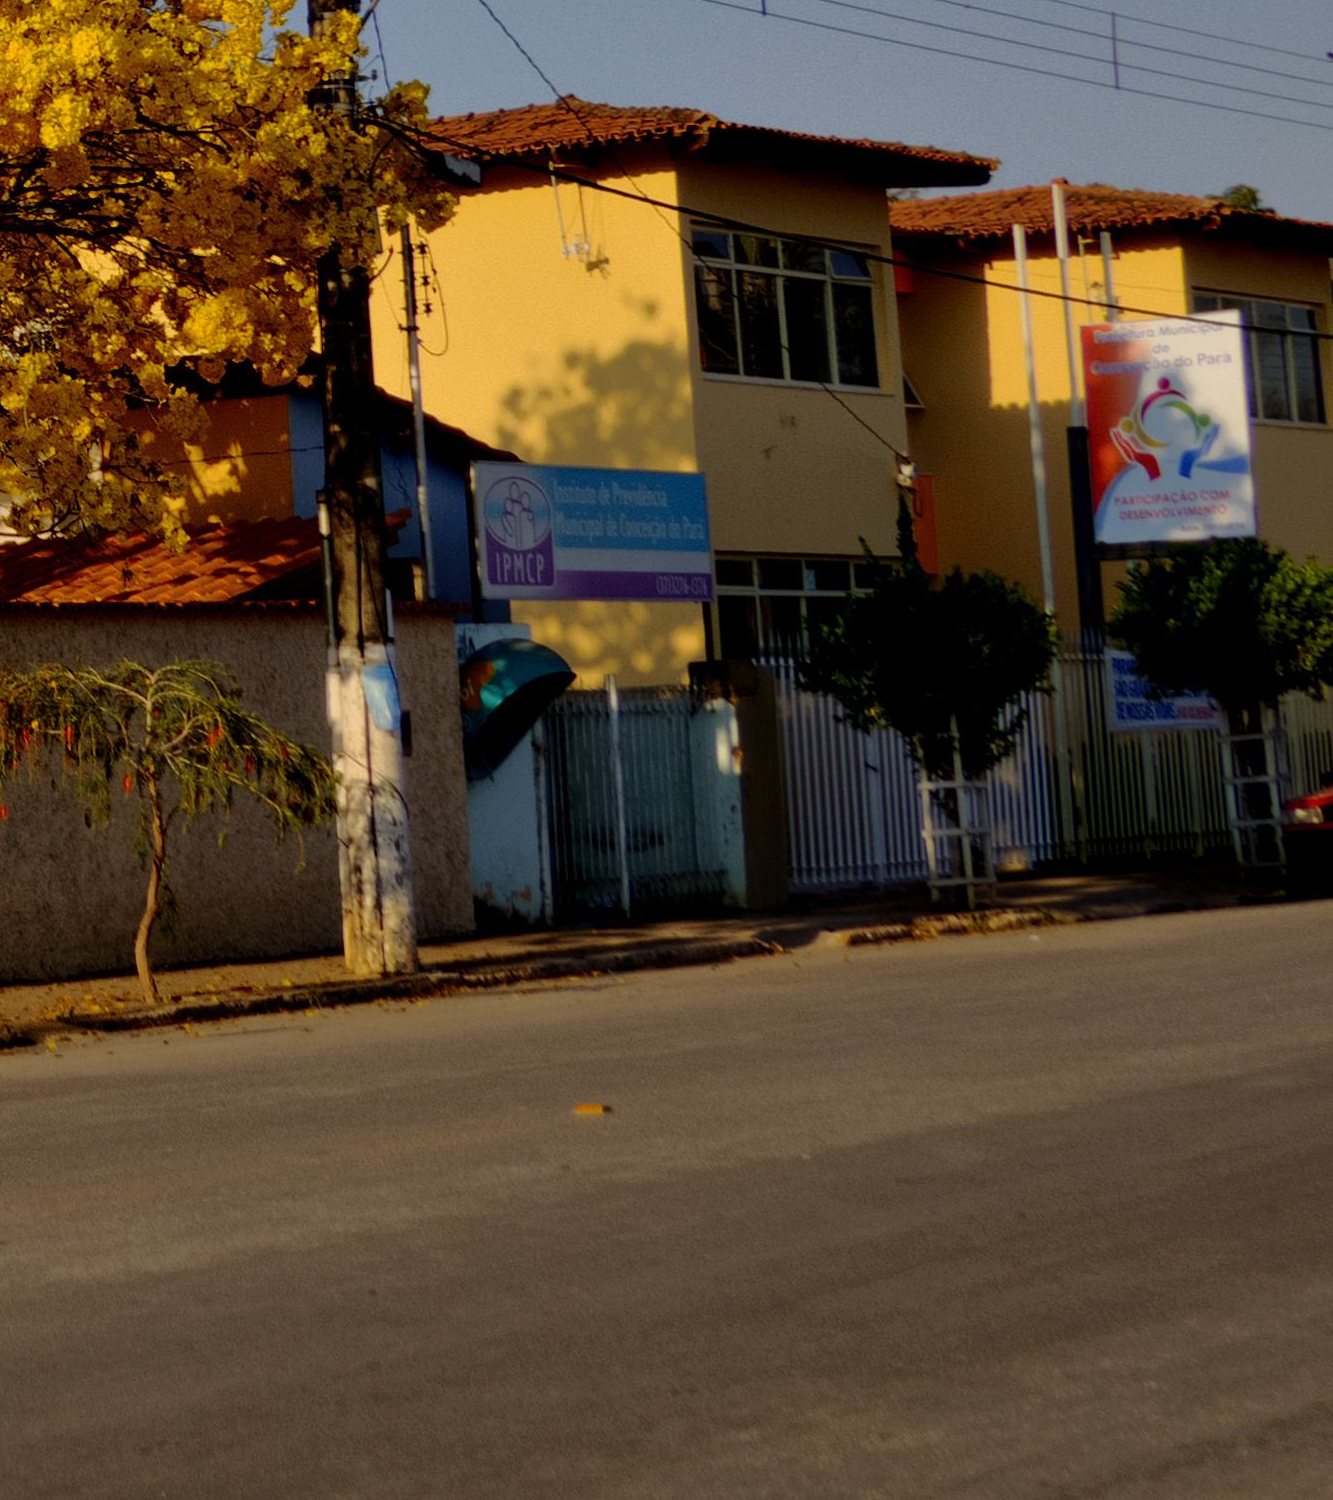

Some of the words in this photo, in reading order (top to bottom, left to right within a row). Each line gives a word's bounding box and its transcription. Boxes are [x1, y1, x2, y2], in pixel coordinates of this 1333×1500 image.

[1159, 319, 1223, 336] Municipal
[1152, 343, 1170, 354] de
[1173, 355, 1193, 368] do
[1197, 351, 1232, 366] Pará
[553, 479, 596, 505] Instituto
[597, 481, 610, 506] de
[612, 480, 668, 508] Previdência
[1115, 488, 1198, 505] PARTICIPAÇÃO
[1200, 489, 1231, 502] COM
[1118, 504, 1228, 520] DESENVOLVIMENTO
[555, 510, 602, 542] Municipal
[603, 513, 618, 537] de
[668, 515, 680, 539] do
[494, 551, 545, 584] IPMCP
